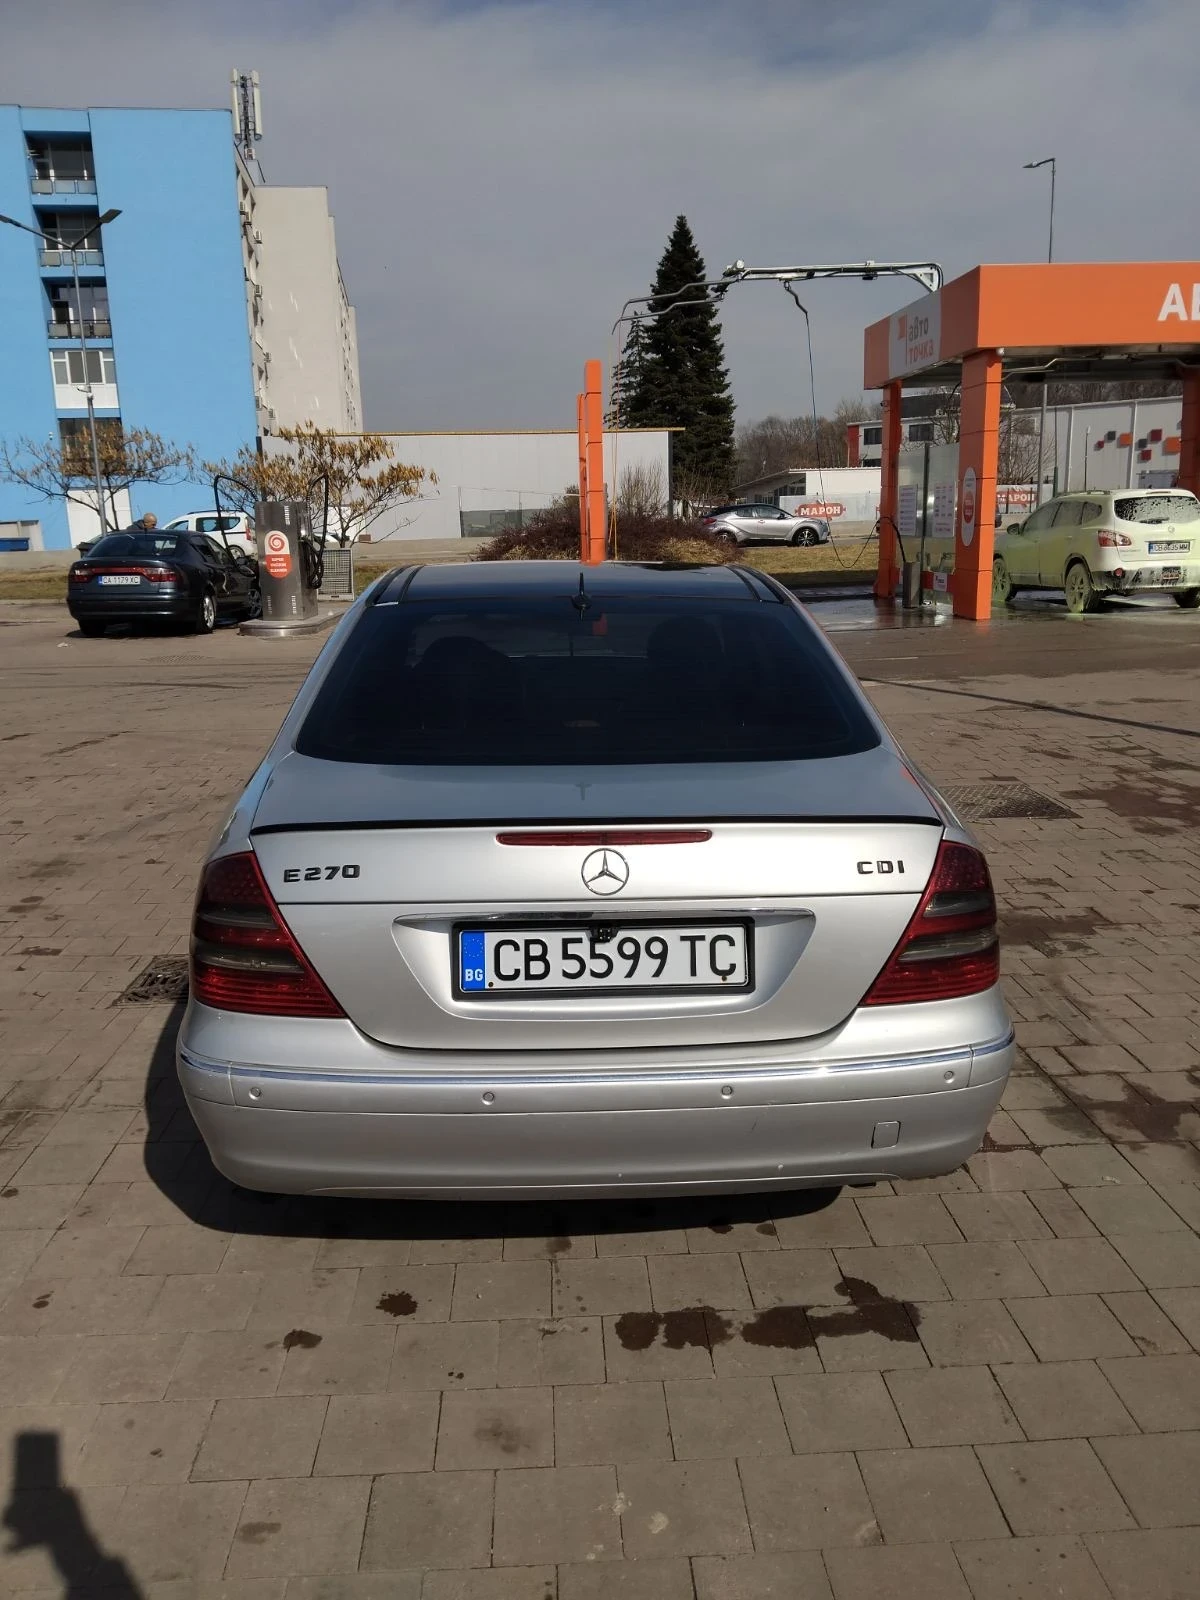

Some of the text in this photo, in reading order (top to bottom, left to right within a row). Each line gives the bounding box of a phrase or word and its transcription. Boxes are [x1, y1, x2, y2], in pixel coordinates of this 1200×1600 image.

[800, 506, 841, 516] МАРОН
[283, 864, 360, 883] E270
[857, 860, 905, 875] CDI
[493, 934, 737, 982] CB 5599 TC
[465, 968, 484, 982] BG
